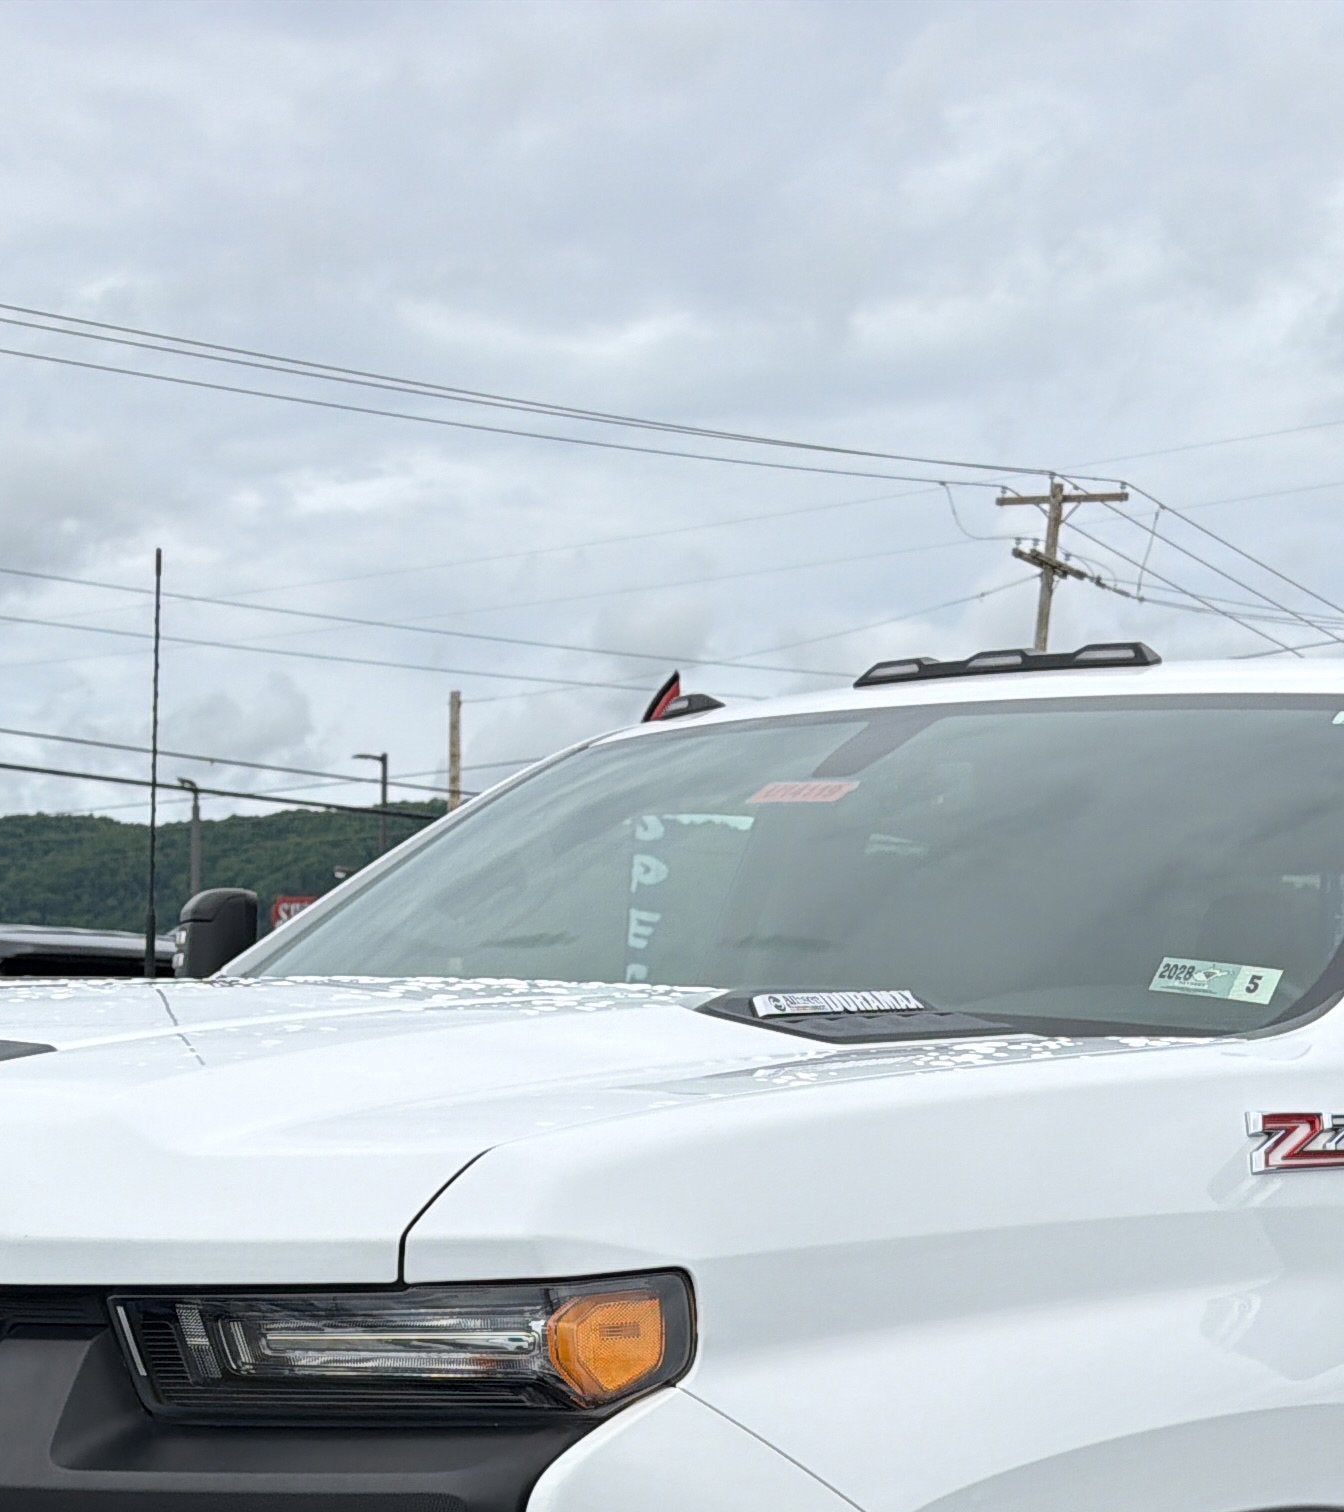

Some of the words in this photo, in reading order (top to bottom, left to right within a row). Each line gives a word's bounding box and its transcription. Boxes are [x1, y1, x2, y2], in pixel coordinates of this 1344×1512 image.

[1159, 963, 1195, 981] 2028
[1245, 975, 1263, 993] 5
[821, 990, 924, 1012] DURAMAX
